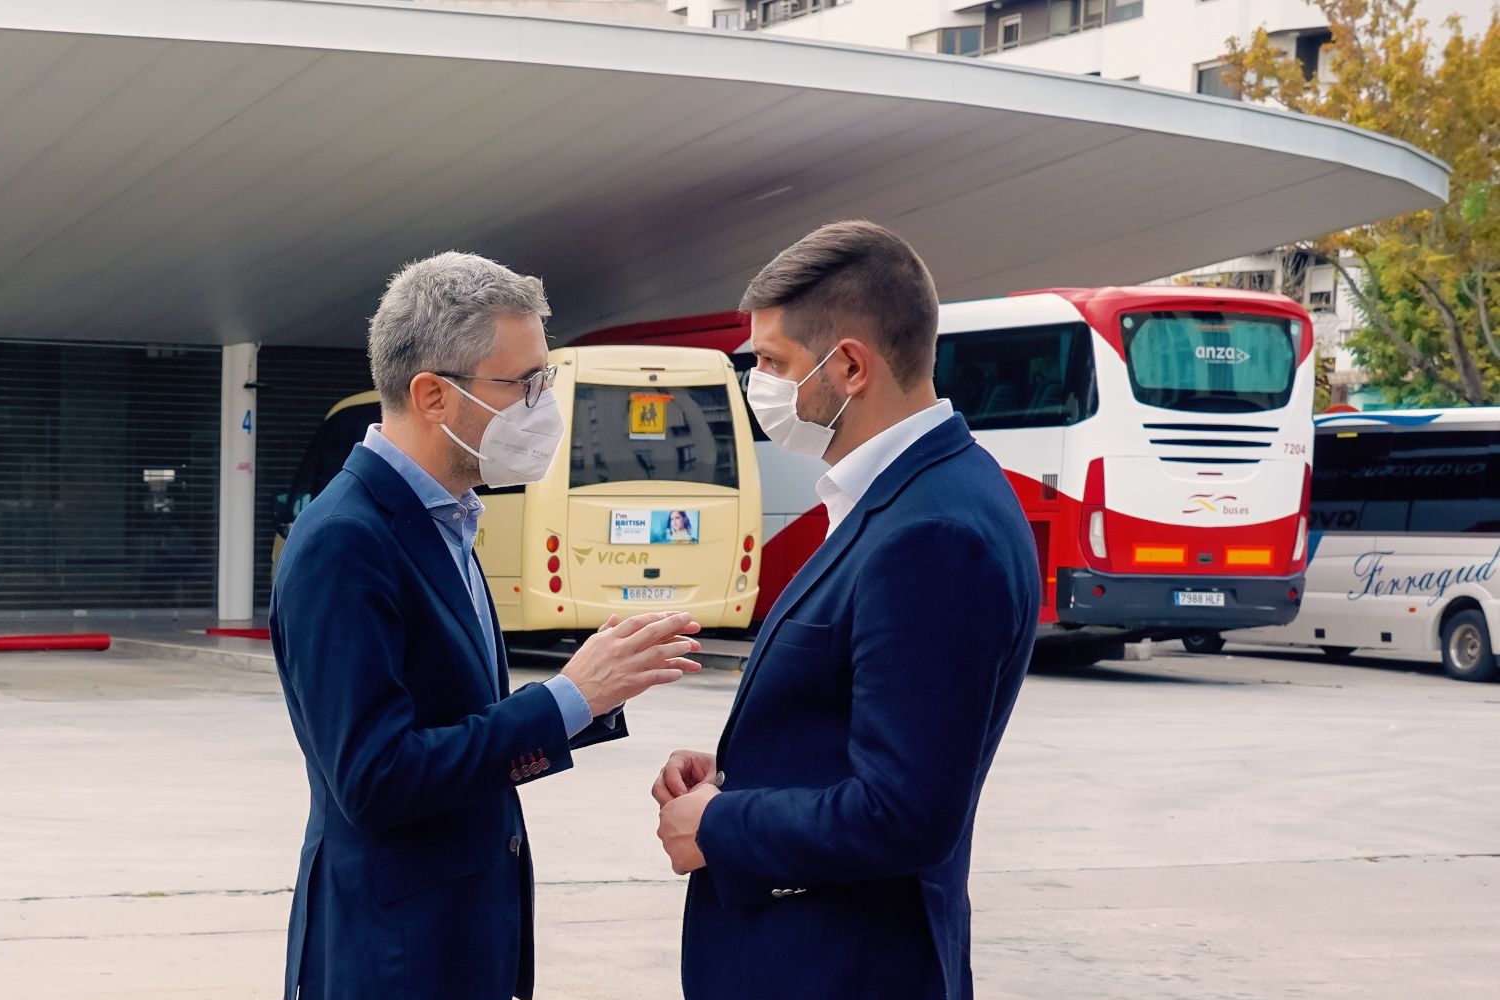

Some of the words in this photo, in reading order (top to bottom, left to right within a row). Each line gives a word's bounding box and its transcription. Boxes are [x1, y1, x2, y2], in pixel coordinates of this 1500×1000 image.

[242, 409, 252, 434] 4
[1284, 443, 1306, 455] 7204
[1223, 505, 1250, 515] bus.es
[598, 552, 650, 566] VICAR
[1205, 593, 1222, 604] HLF
